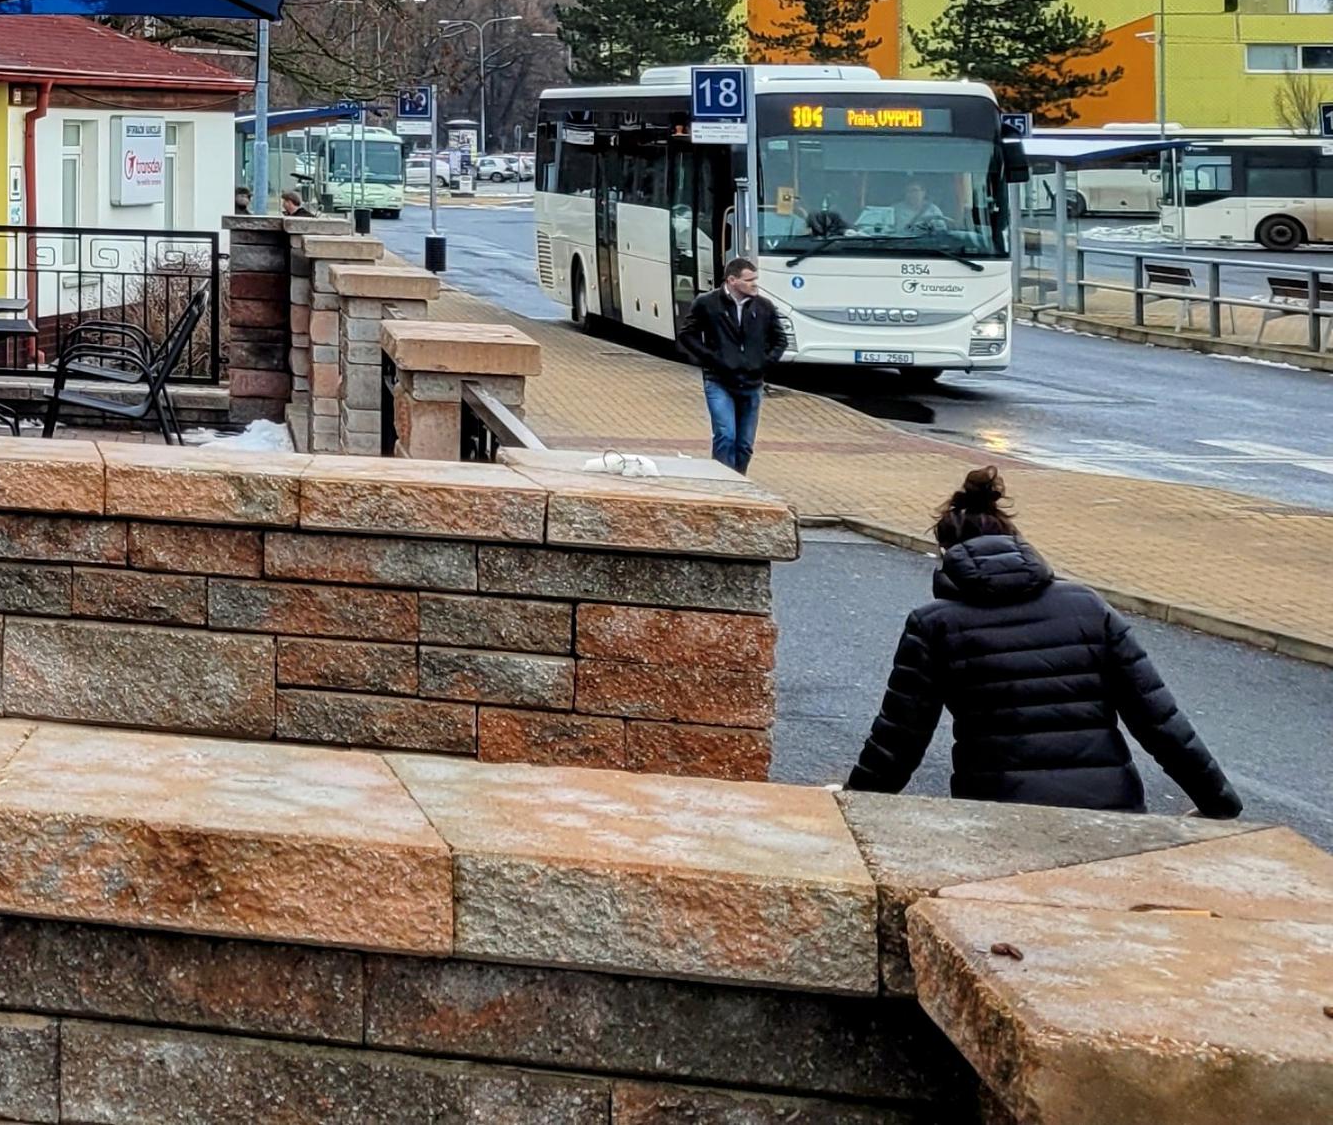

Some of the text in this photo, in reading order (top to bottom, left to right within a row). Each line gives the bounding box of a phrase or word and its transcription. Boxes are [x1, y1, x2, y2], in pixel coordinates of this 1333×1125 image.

[699, 78, 738, 107] 18
[900, 263, 931, 276] 8354
[921, 283, 964, 293] transdev
[847, 306, 920, 324] IVECO
[886, 353, 910, 363] 2560
